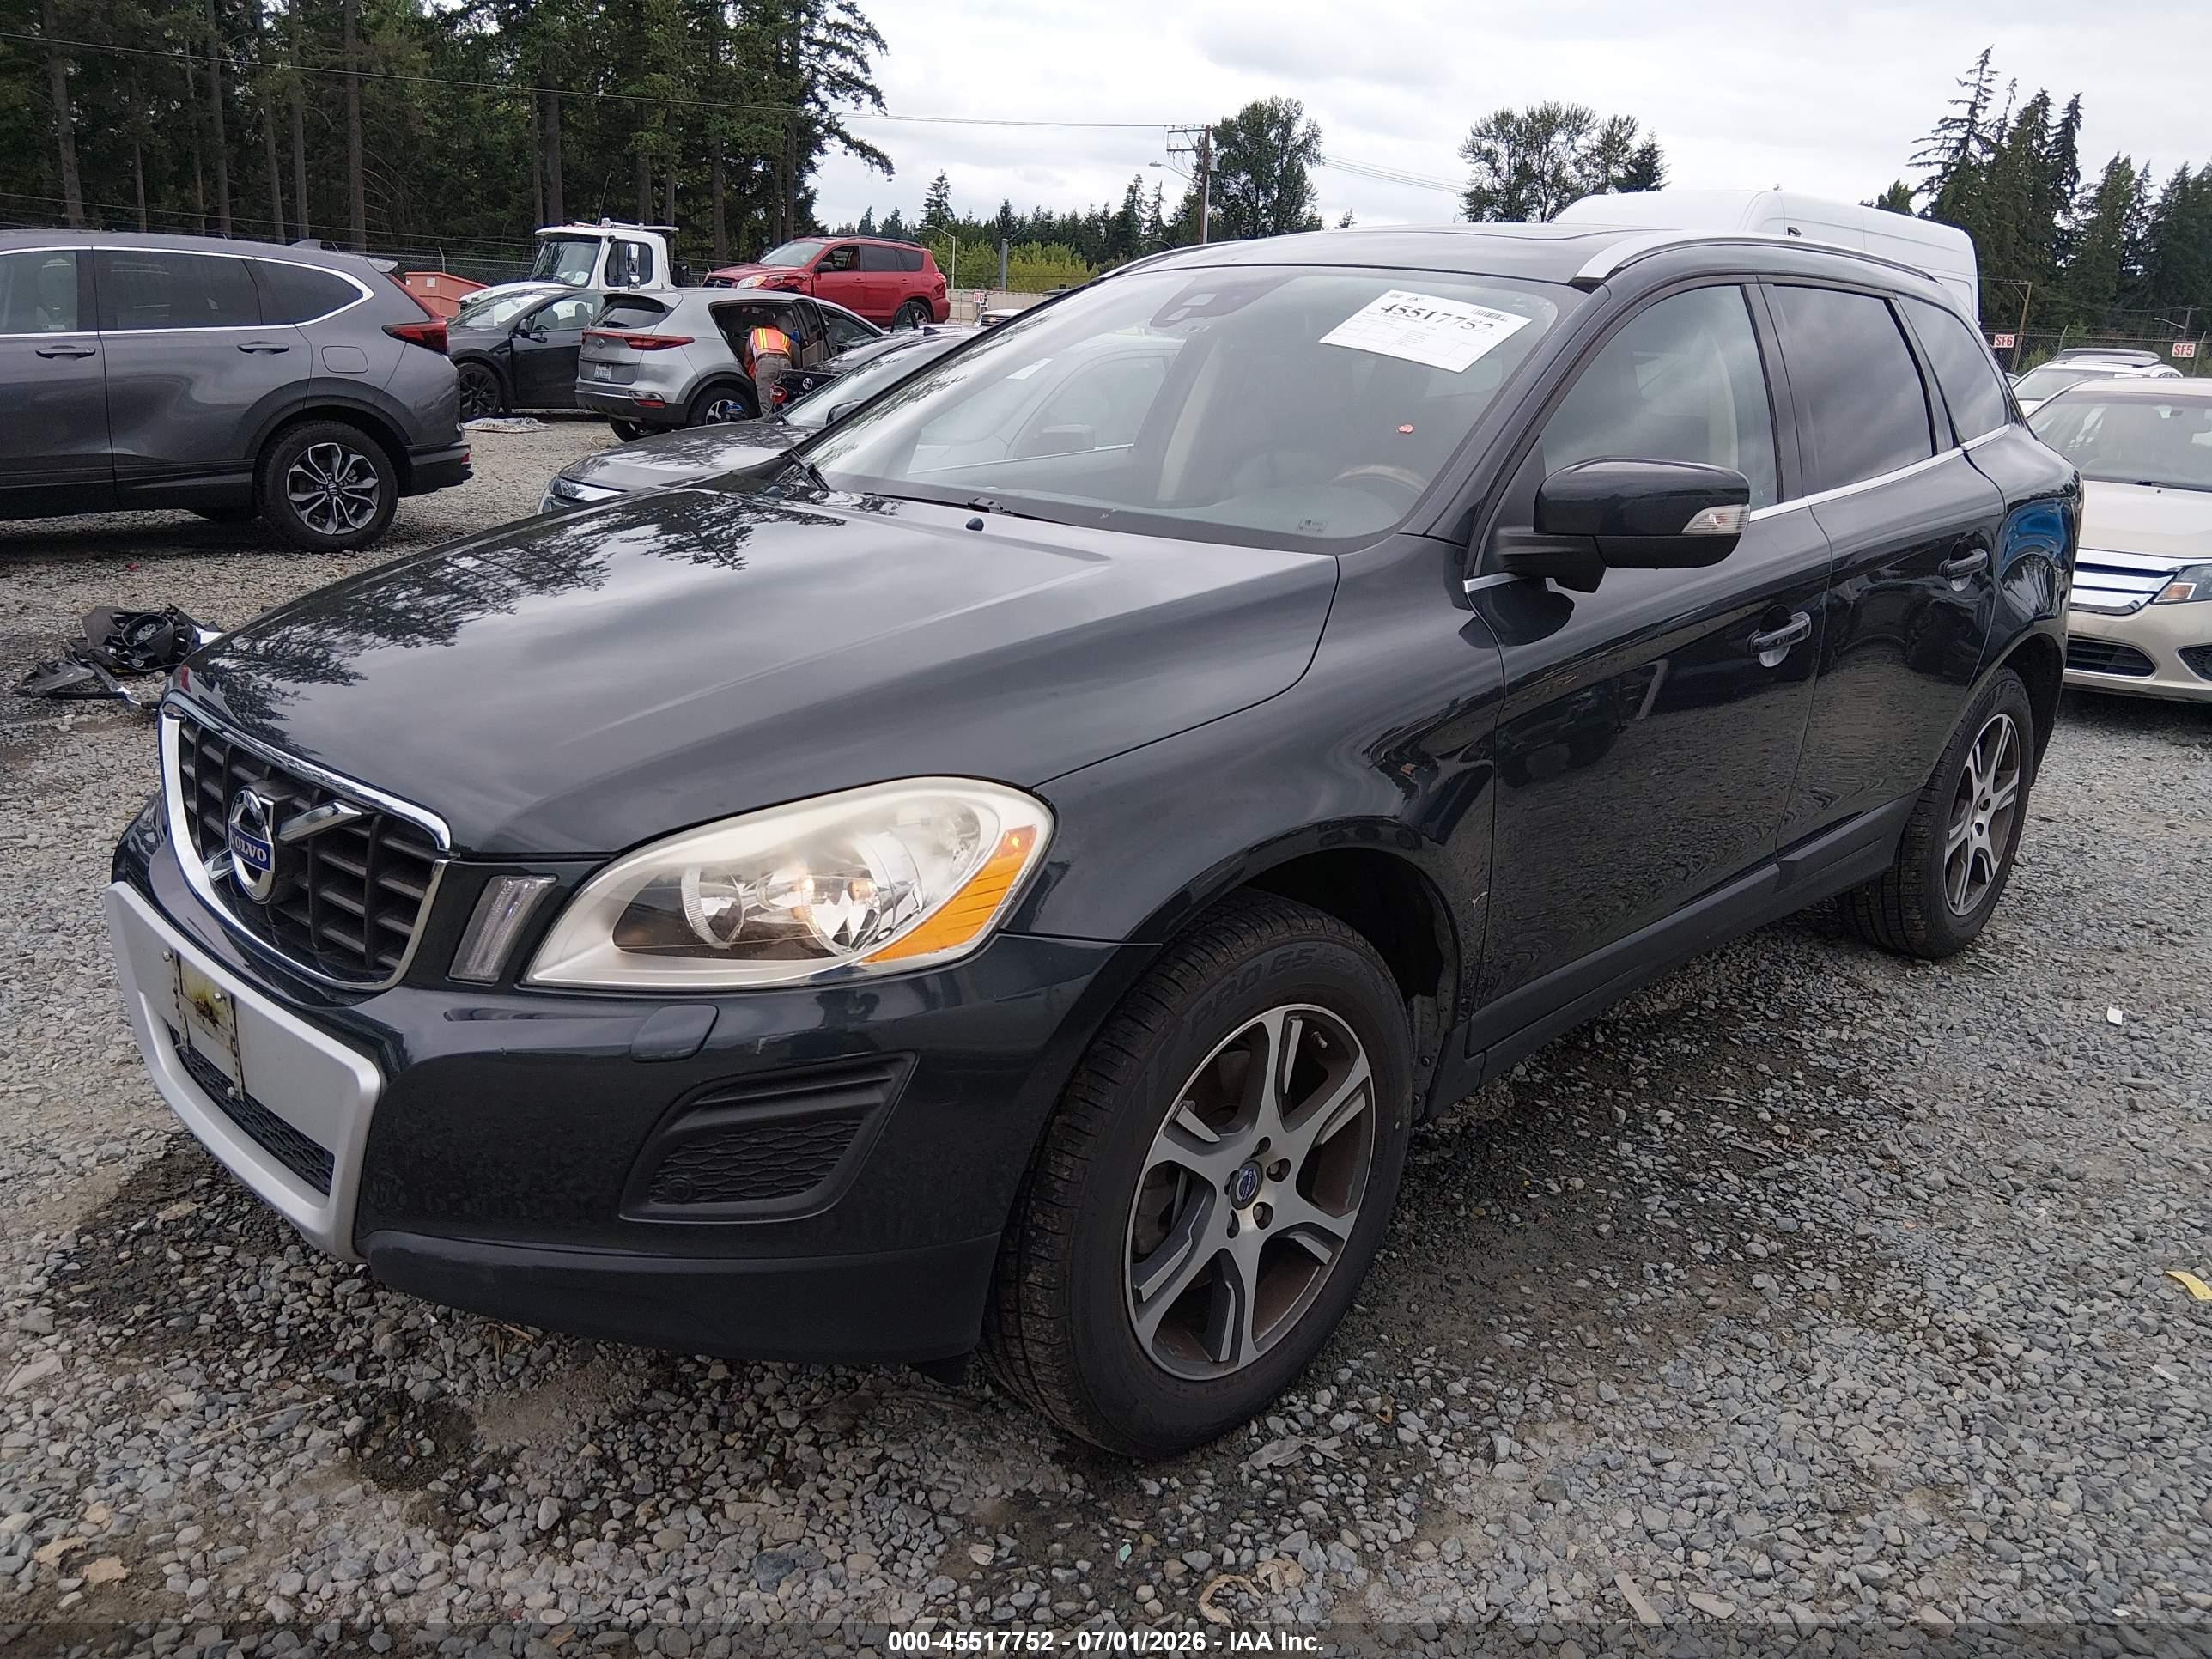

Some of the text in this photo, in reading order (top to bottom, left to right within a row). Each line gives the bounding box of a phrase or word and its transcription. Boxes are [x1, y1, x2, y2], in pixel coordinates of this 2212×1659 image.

[1380, 303, 1495, 331] 45517752
[1996, 336, 2014, 347] SF6
[2173, 344, 2194, 356] SF5
[231, 833, 267, 863] VOLVO
